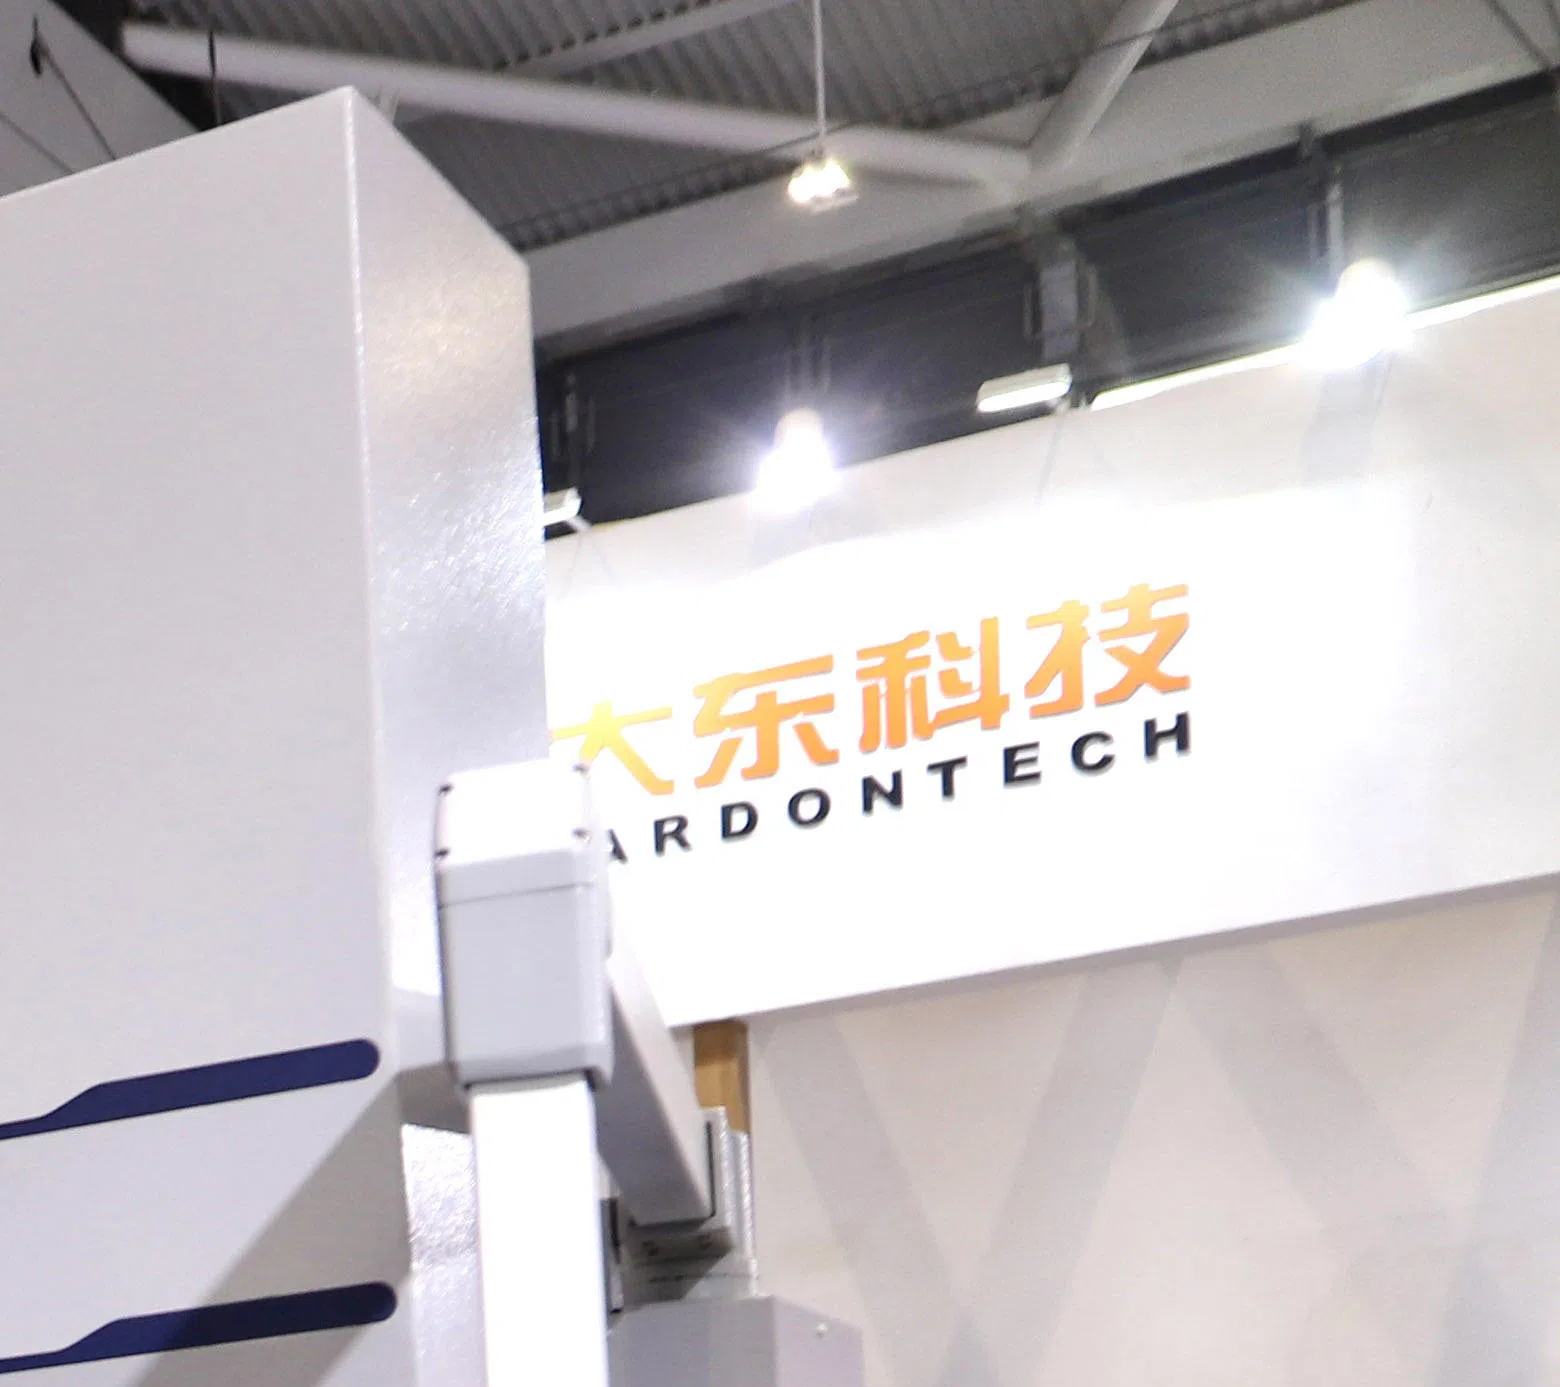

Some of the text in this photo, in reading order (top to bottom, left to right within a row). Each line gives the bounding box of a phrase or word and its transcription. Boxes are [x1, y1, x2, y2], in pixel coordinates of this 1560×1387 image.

[549, 583, 1192, 796] 大东科技
[607, 711, 1193, 864] ARDONTECH
